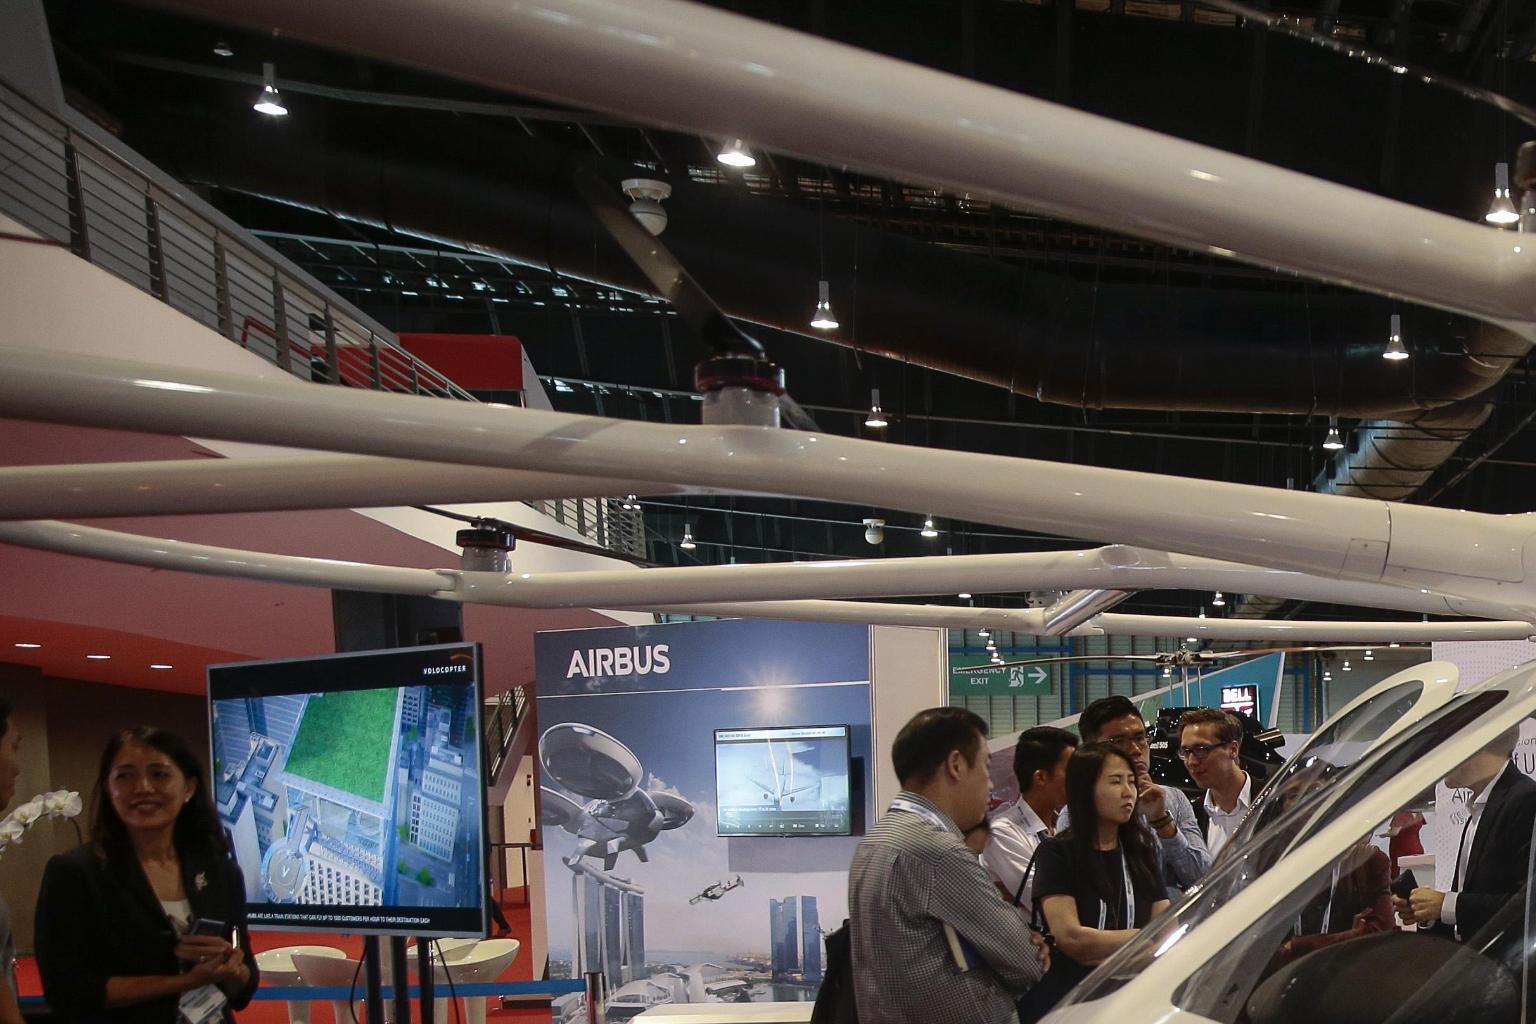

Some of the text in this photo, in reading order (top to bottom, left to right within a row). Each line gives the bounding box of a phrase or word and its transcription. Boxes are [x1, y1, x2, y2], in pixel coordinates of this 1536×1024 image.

[566, 644, 671, 678] AIRBUS
[423, 665, 466, 675] VOLOCOPTER
[970, 677, 989, 685] EXIT
[1222, 688, 1252, 702] BELL
